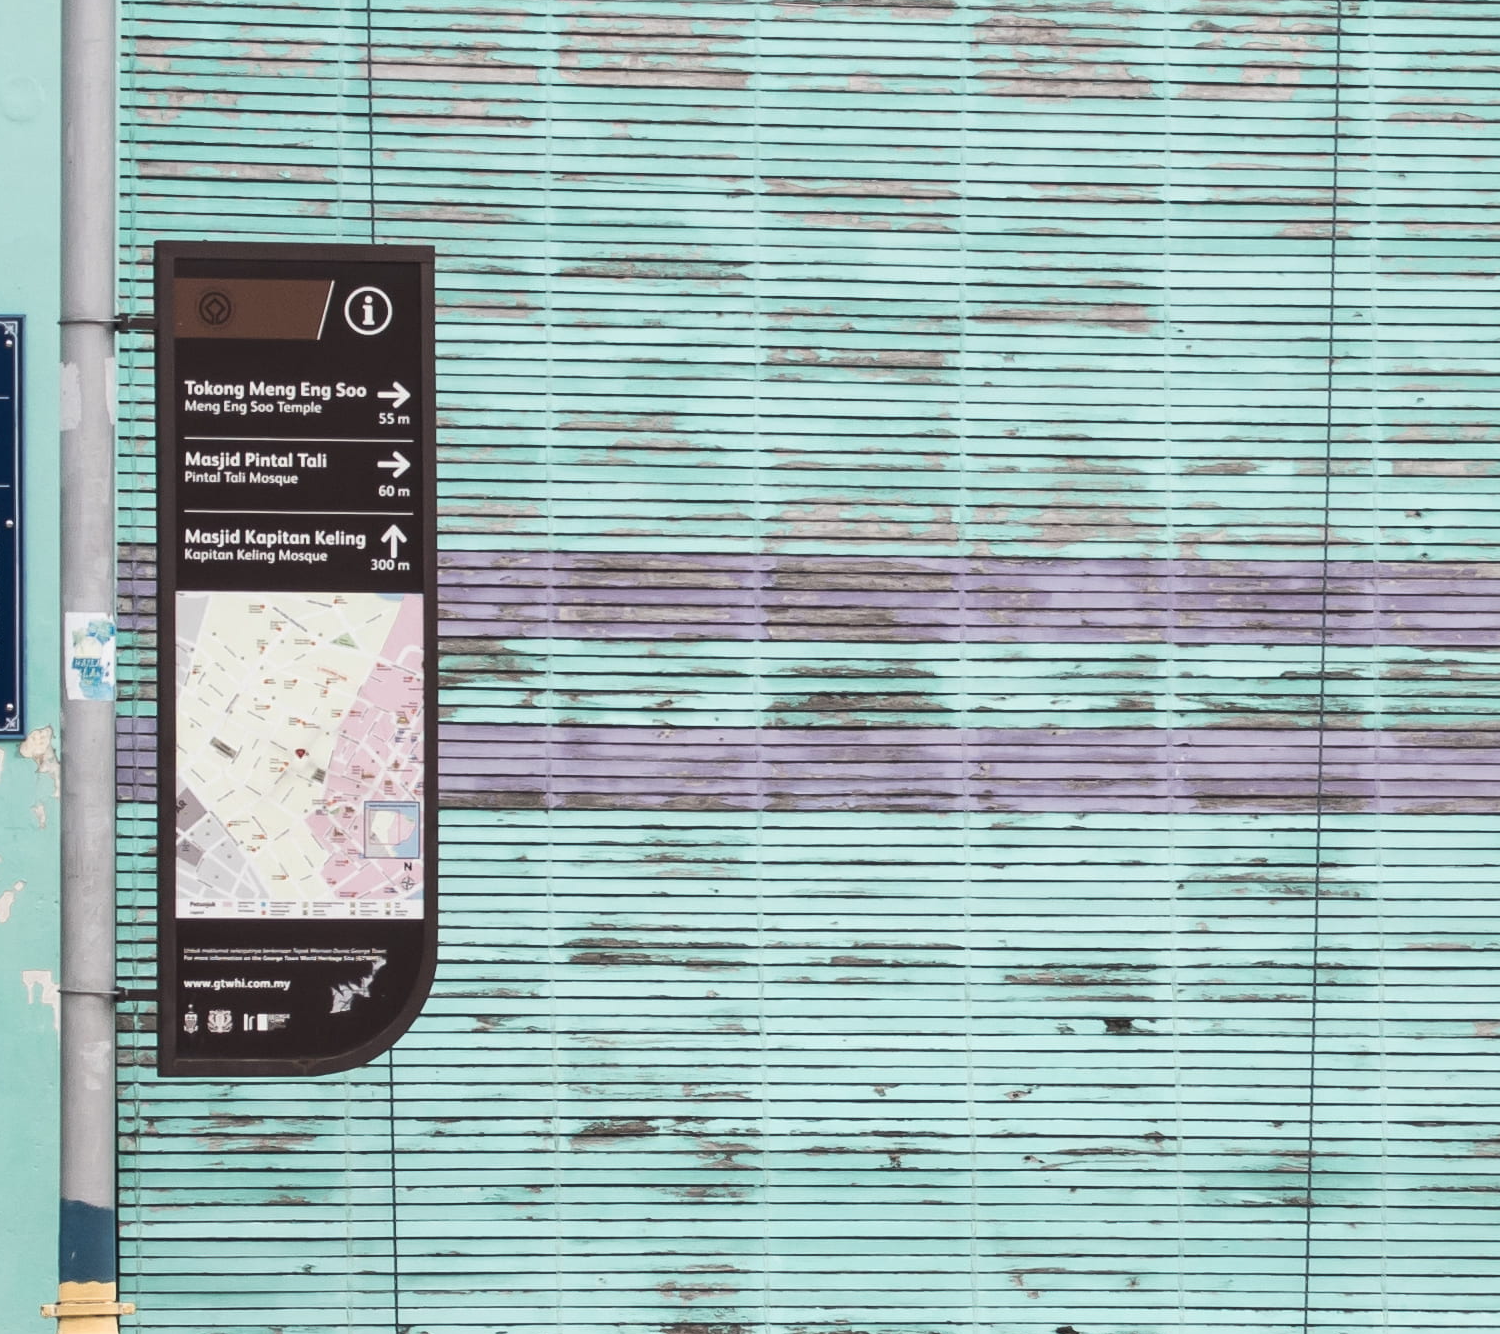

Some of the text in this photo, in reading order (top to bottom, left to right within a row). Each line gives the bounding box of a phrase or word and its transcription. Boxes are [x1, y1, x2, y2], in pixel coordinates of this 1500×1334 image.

[185, 380, 367, 400] Tokong Meng Eng Soo
[185, 400, 322, 417] Meng Eng Soo Temple
[379, 413, 410, 424] 55 m
[185, 452, 327, 470] Masjid Pintal Tali
[185, 471, 298, 486] Pintal Tali Mosque
[379, 486, 410, 497] 60 m
[185, 528, 367, 549] Masjid Kapitan Keling
[185, 549, 328, 564] Kapitan Keling Mosque
[371, 560, 410, 571] 300 m
[404, 862, 412, 871] N
[183, 978, 290, 991] www.gtwhi.com.my
